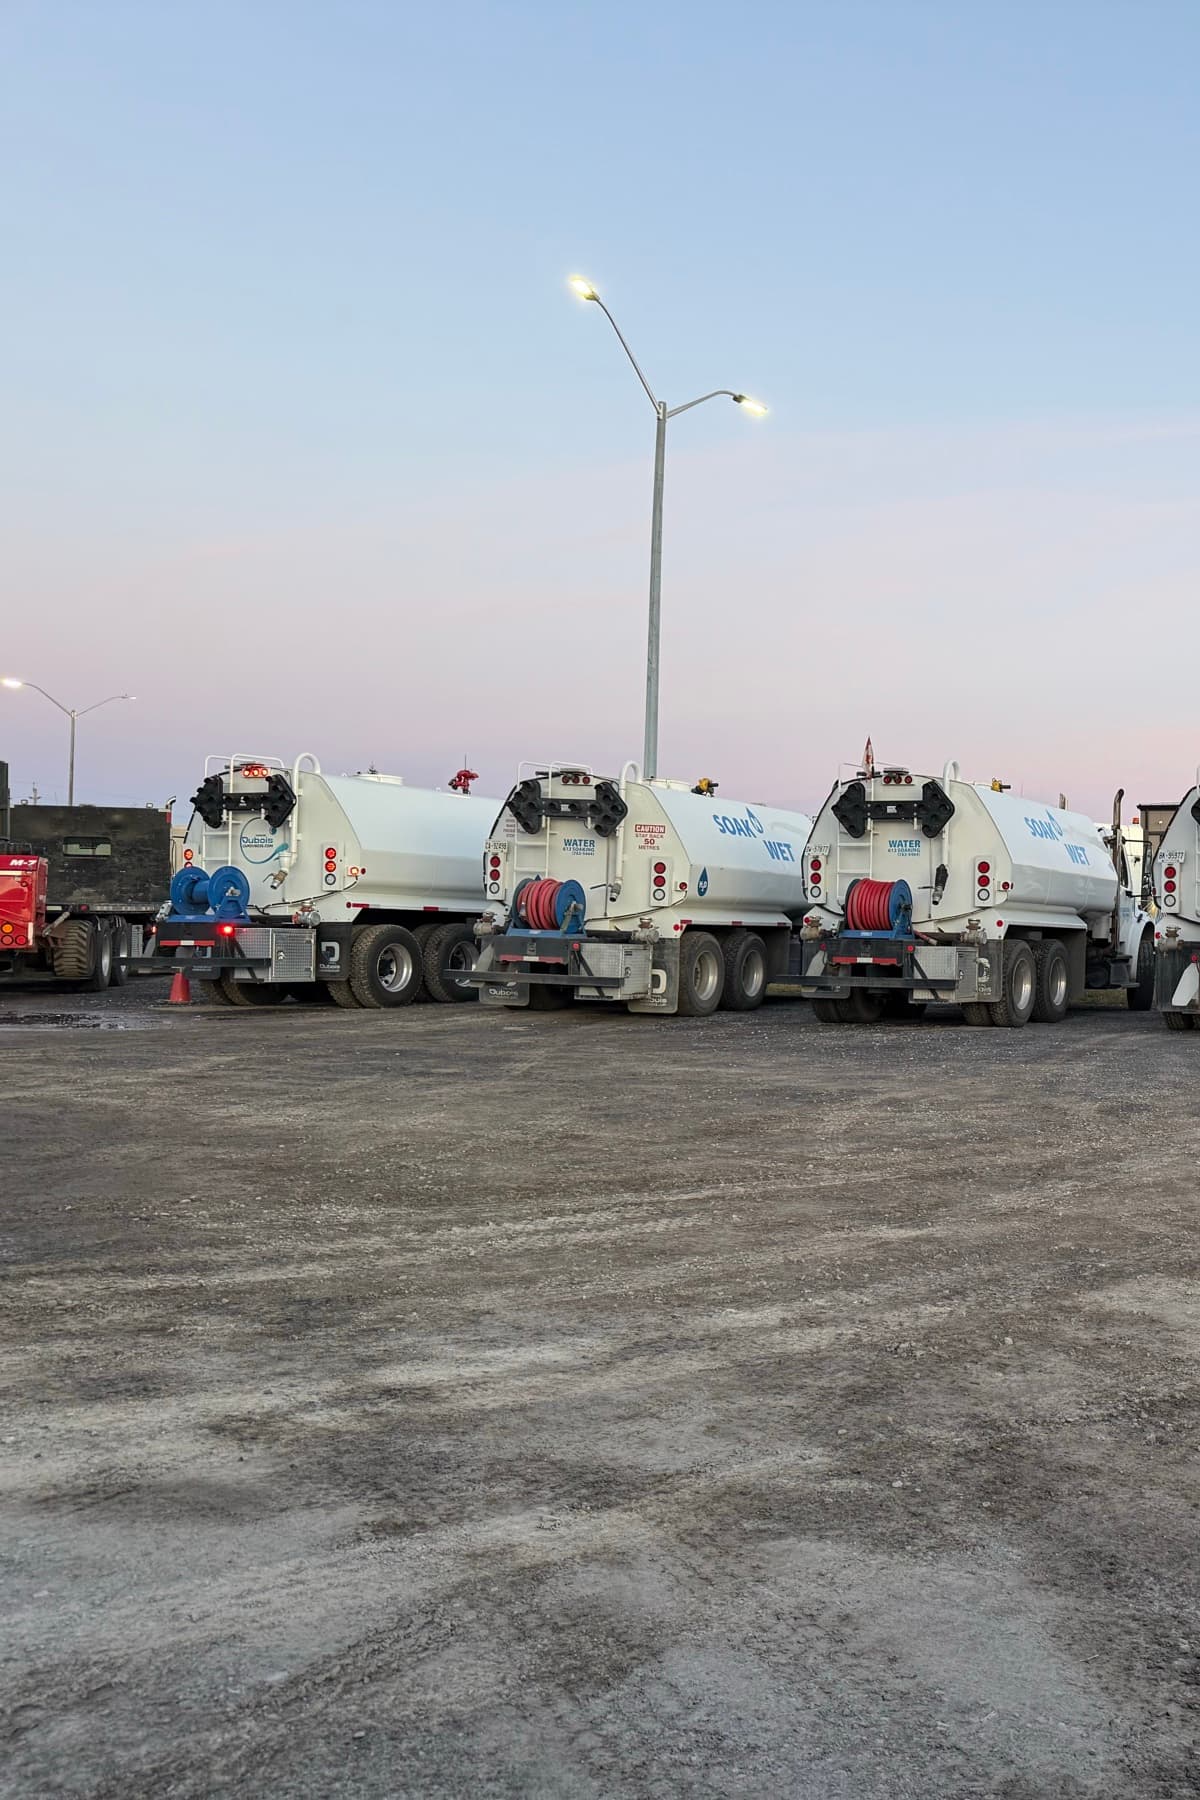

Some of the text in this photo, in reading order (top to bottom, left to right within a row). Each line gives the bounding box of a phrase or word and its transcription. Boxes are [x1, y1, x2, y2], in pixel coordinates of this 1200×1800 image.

[712, 814, 757, 838] SOAK
[1024, 816, 1059, 841] SOAK
[563, 838, 595, 847] WATER
[762, 840, 795, 862] WET
[888, 839, 921, 848] WATER
[1064, 843, 1090, 866] WET
